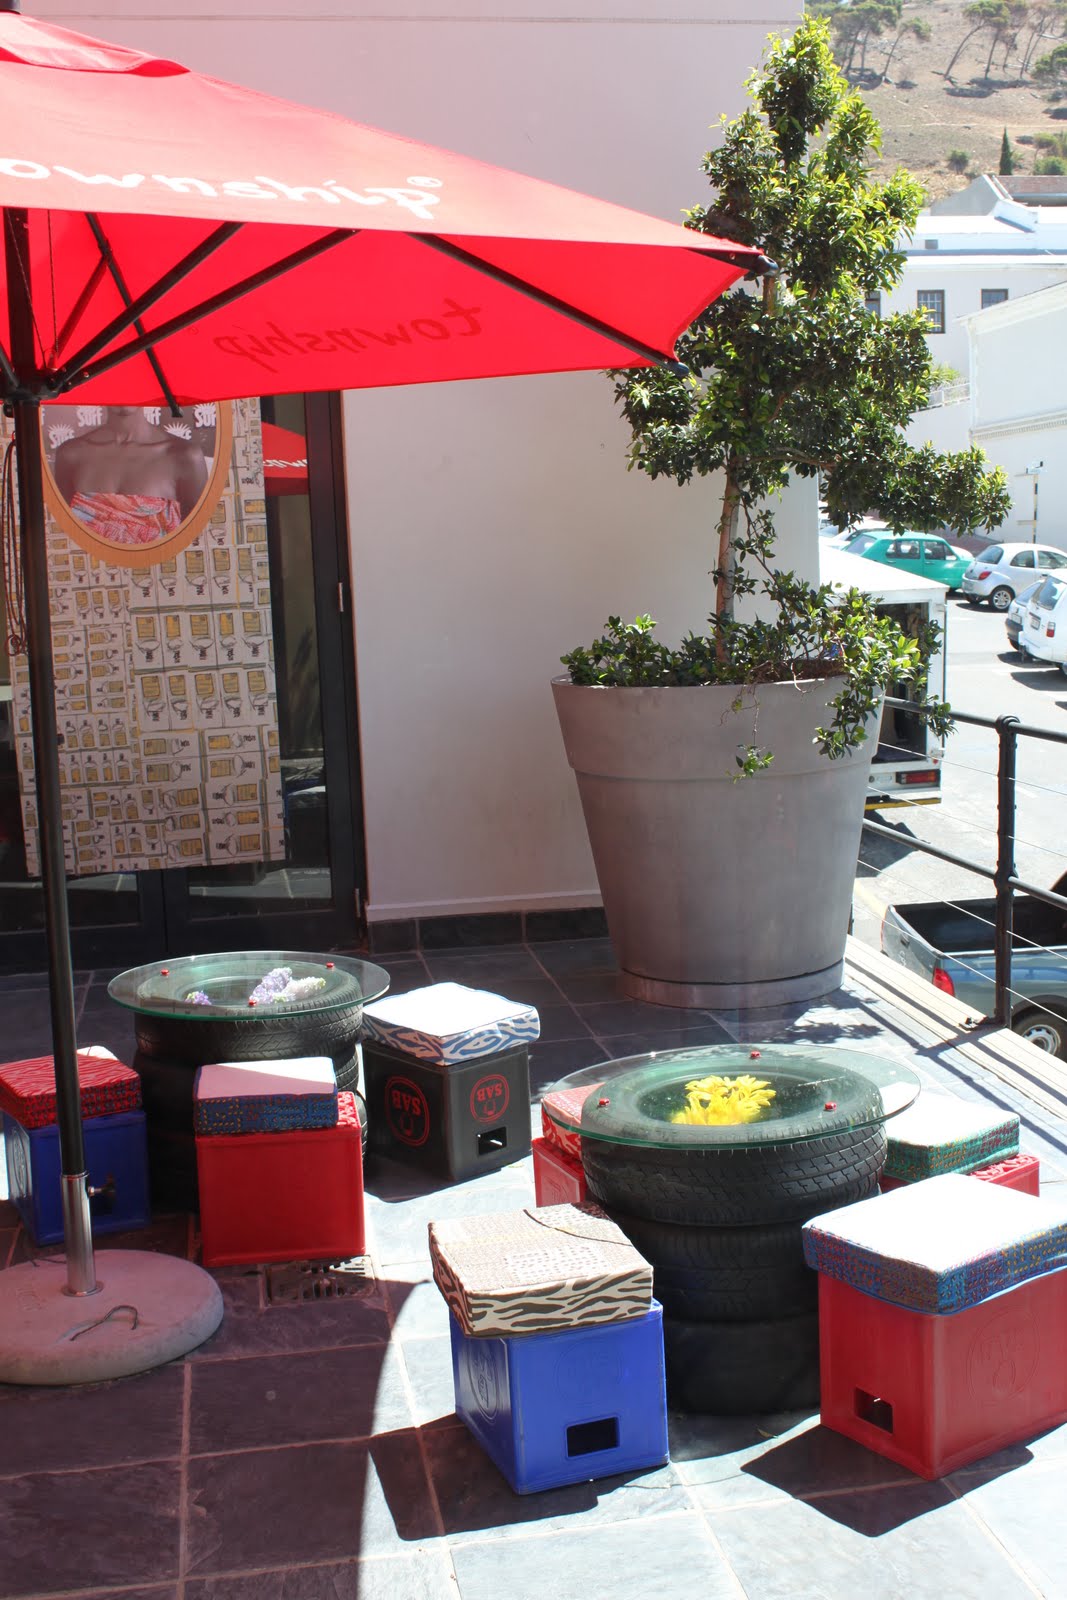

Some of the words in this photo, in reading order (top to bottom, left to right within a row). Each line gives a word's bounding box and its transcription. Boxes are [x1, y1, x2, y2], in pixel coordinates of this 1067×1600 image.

[76, 406, 103, 427] Surf
[143, 407, 161, 426] urf
[194, 407, 216, 428] Sur
[391, 1089, 421, 1116] SAB
[477, 1082, 503, 1102] SAB
